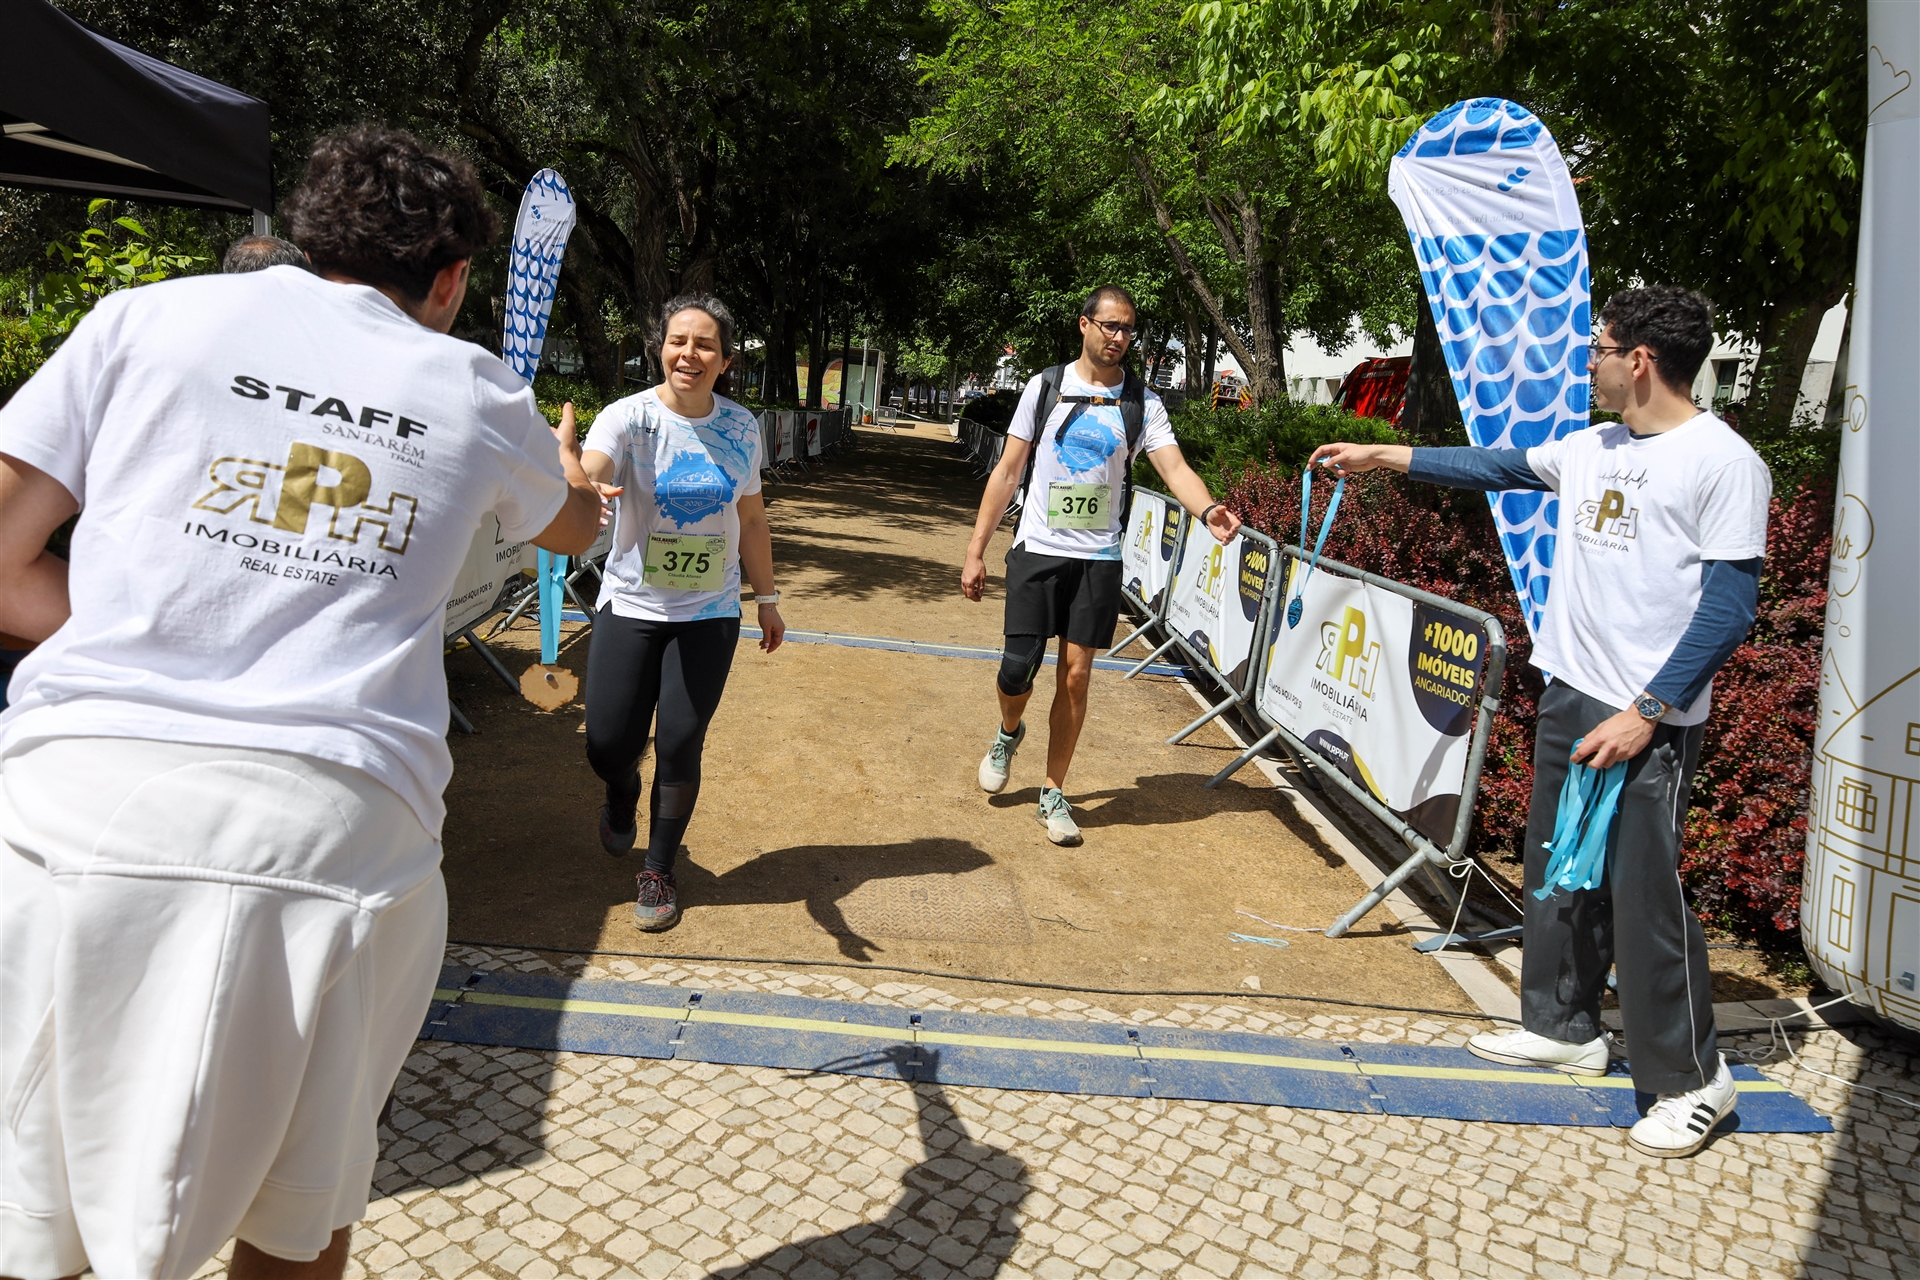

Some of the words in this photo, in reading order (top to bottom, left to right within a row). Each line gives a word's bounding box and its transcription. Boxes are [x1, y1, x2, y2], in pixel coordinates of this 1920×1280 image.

[230, 375, 428, 439] STAFF
[322, 422, 426, 460] SANTARÉM
[389, 453, 424, 469] TRAIL
[1062, 496, 1098, 515] 376
[184, 522, 398, 580] IMOBILIÁRIA
[662, 550, 711, 574] 375
[240, 557, 279, 578] REAL
[283, 566, 339, 586] ESTATE
[446, 594, 468, 610] ESTAMOS
[468, 587, 480, 599] AQUI
[479, 583, 489, 595] POR
[1424, 622, 1478, 661] +1000
[1417, 652, 1475, 689] IMÓVEIS
[1310, 677, 1368, 722] IMOBILIÁRIA
[1415, 676, 1471, 708] ANGARIADOS
[1332, 708, 1354, 725] ESTATE
